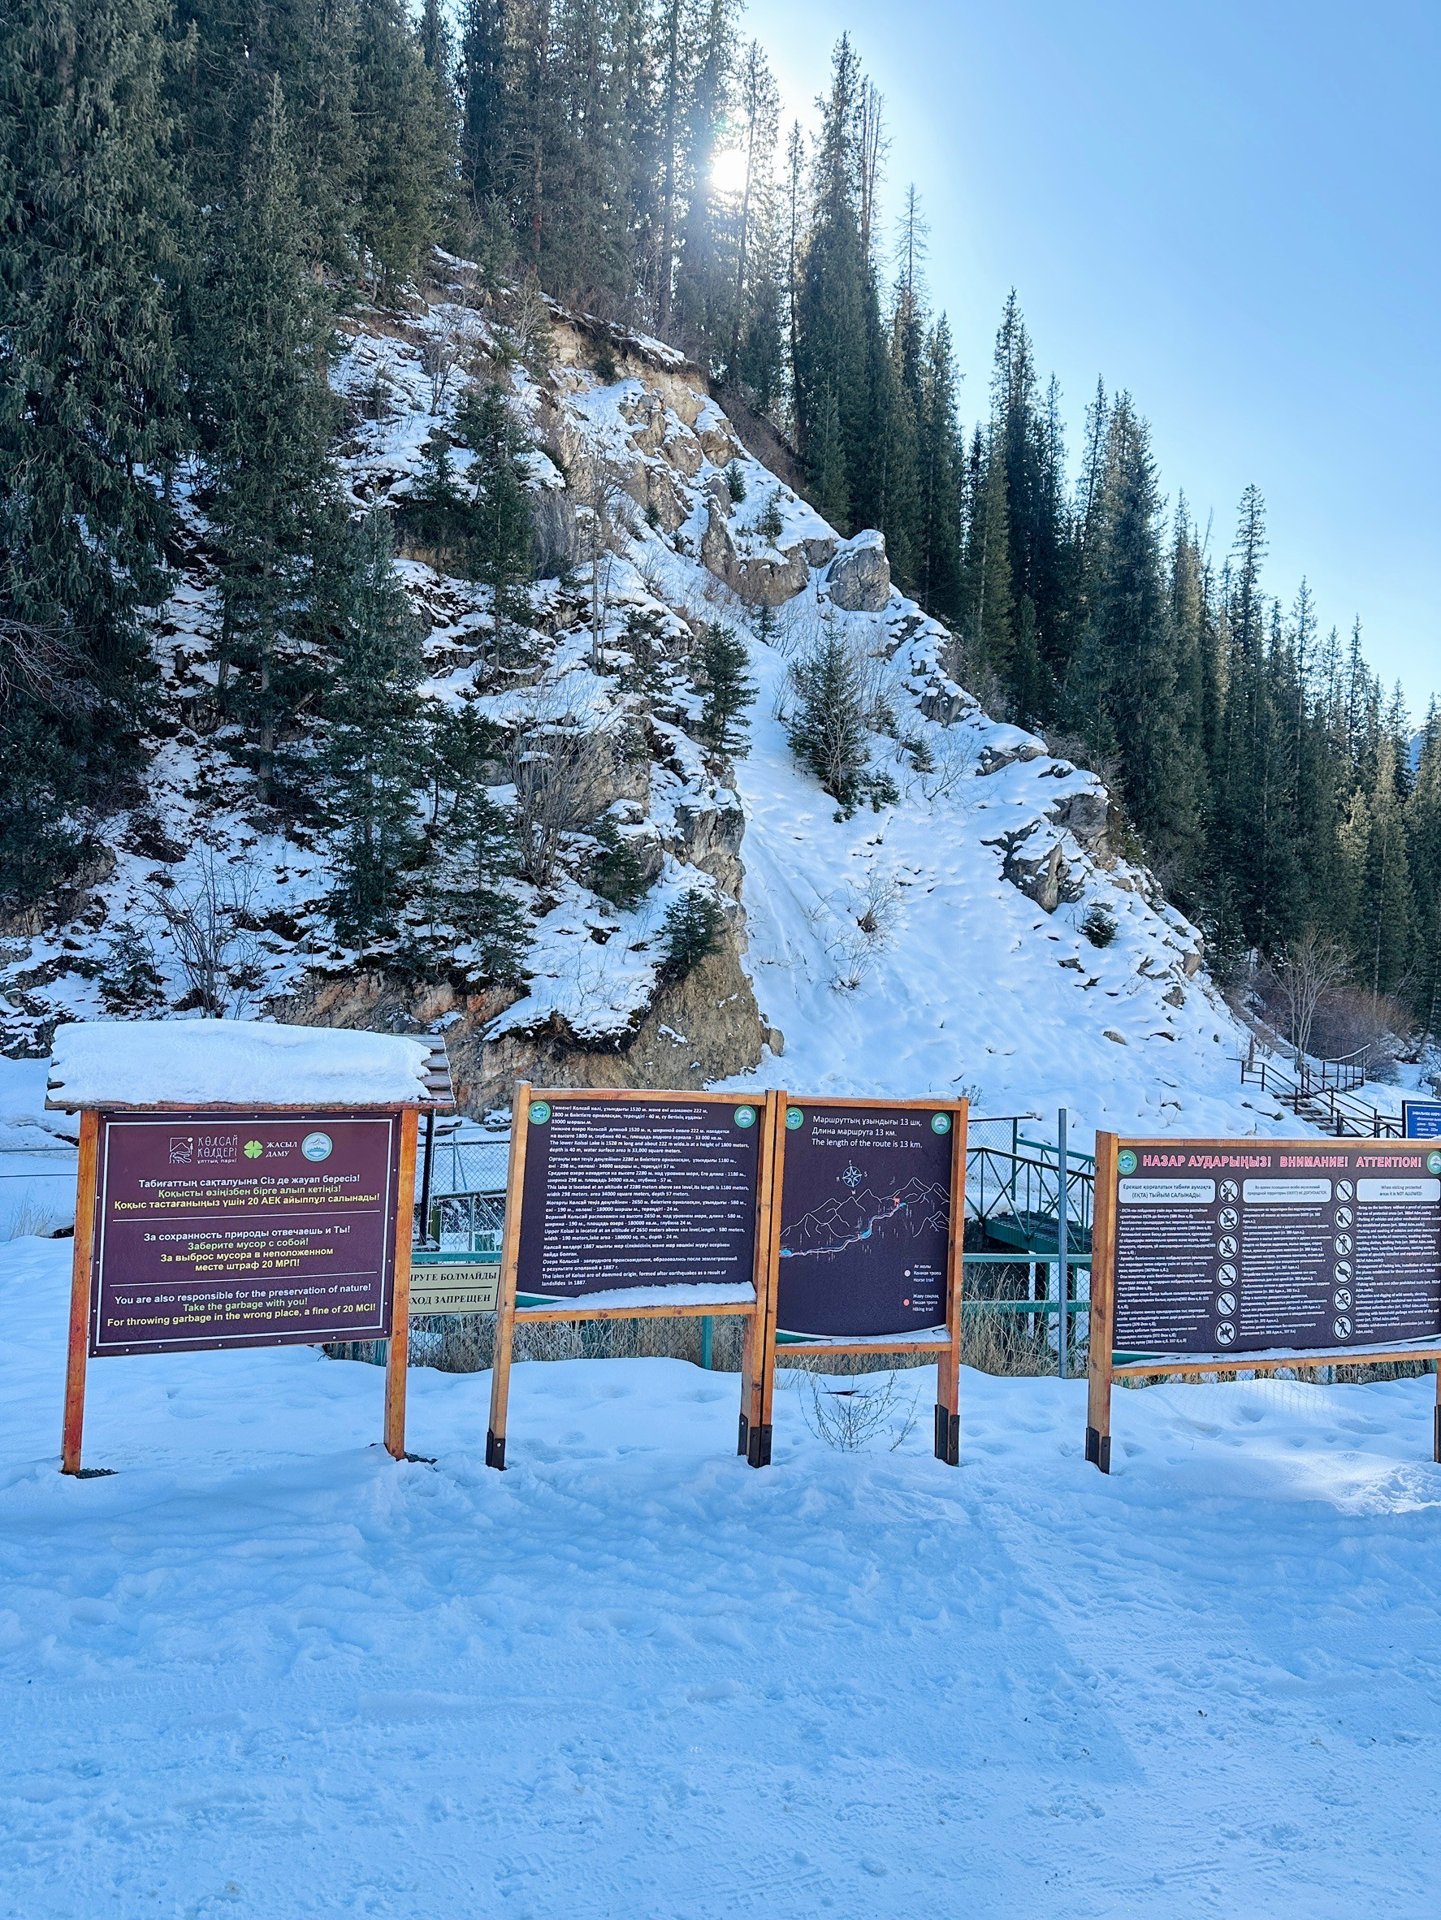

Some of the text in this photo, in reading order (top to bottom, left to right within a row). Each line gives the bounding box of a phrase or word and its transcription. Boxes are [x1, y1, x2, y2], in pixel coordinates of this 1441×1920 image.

[812, 1116, 860, 1126] Маршруттың
[862, 1118, 899, 1126] ұзындығы
[812, 1127, 835, 1136] Длина
[837, 1129, 874, 1137] маршрута
[197, 1134, 238, 1147] КӨЛСАЙ
[826, 1139, 849, 1148] length
[197, 1147, 237, 1158] КӨЛДЕРІ
[1142, 1155, 1272, 1169] НАЗАР АУДАРЫҢЫЗ!
[1279, 1156, 1349, 1168] ВНИМАНИЕ!
[1356, 1156, 1422, 1168] ATTENTION!
[138, 1174, 360, 1188] Табиғаттың сақталуына Сіз де жауап бересіз!
[158, 1189, 204, 1198] Қоқысты
[205, 1187, 251, 1197] өзіңізбен
[253, 1186, 278, 1196] бірге
[308, 1185, 341, 1194] кетіңіз!
[114, 1193, 380, 1210] Қоқыс тастағаныңыз үшін 20 АЕК айыппұл салынады!
[144, 1233, 156, 1241] За
[159, 1231, 222, 1242] сохранность
[225, 1230, 269, 1239] природы
[271, 1227, 323, 1236] отвечаешь
[334, 1225, 351, 1234] Ты!
[188, 1241, 234, 1251] Заберите
[236, 1242, 266, 1250] мусор
[276, 1238, 309, 1246] собой!
[160, 1253, 173, 1262] За
[175, 1252, 214, 1262] выброс
[216, 1252, 252, 1261] мусора
[263, 1248, 334, 1258] неположенном
[195, 1258, 300, 1271] месте штраф 20 МРП!
[410, 1272, 497, 1282] ІРУГЕ БОЛМАЙДЫ
[115, 1283, 371, 1305] You are also responsible for the preservation of nature!
[409, 1294, 491, 1305] ХОД ЗАПРЕЩЕН
[183, 1297, 308, 1312] Take the garbage with you!
[107, 1318, 125, 1327] For
[126, 1316, 170, 1326] throwing
[172, 1314, 212, 1325] garbage
[214, 1313, 223, 1321] in
[225, 1311, 241, 1320] the
[242, 1310, 272, 1320] wrong
[274, 1308, 302, 1319] place,
[312, 1307, 329, 1315] fine
[331, 1305, 341, 1314] of
[342, 1304, 353, 1313] 20
[355, 1303, 376, 1312] MCI!
